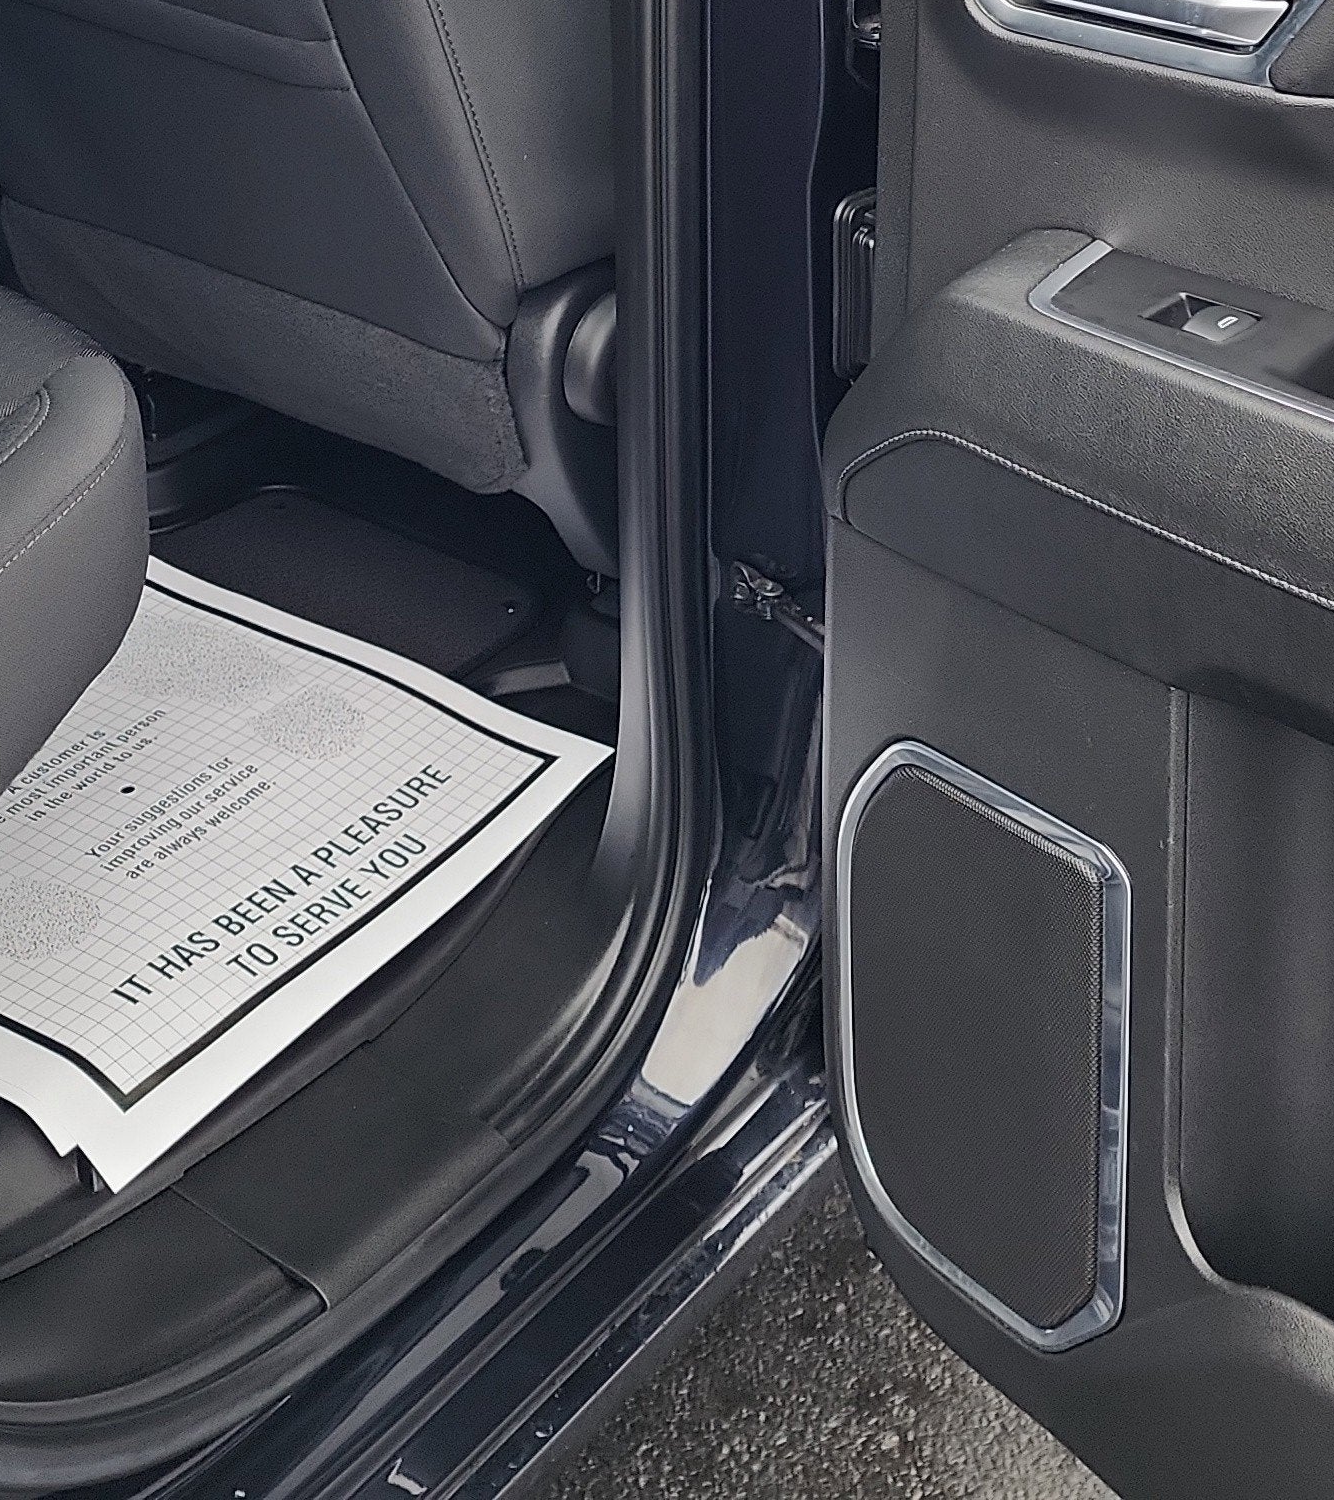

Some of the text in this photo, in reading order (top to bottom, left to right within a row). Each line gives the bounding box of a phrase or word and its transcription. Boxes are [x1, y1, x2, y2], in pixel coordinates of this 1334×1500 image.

[6, 786, 48, 816] most
[45, 740, 119, 789] important
[118, 708, 167, 744] person
[7, 728, 106, 795] A customer is
[25, 736, 159, 822] in the world to us.
[85, 756, 234, 860] Your suggestions for
[100, 763, 259, 873] improving our service
[126, 780, 276, 880] are always welcome.
[111, 764, 453, 1006] IT HAS BEEN A PLEASURE
[225, 833, 428, 979] TO SERVE YOU
